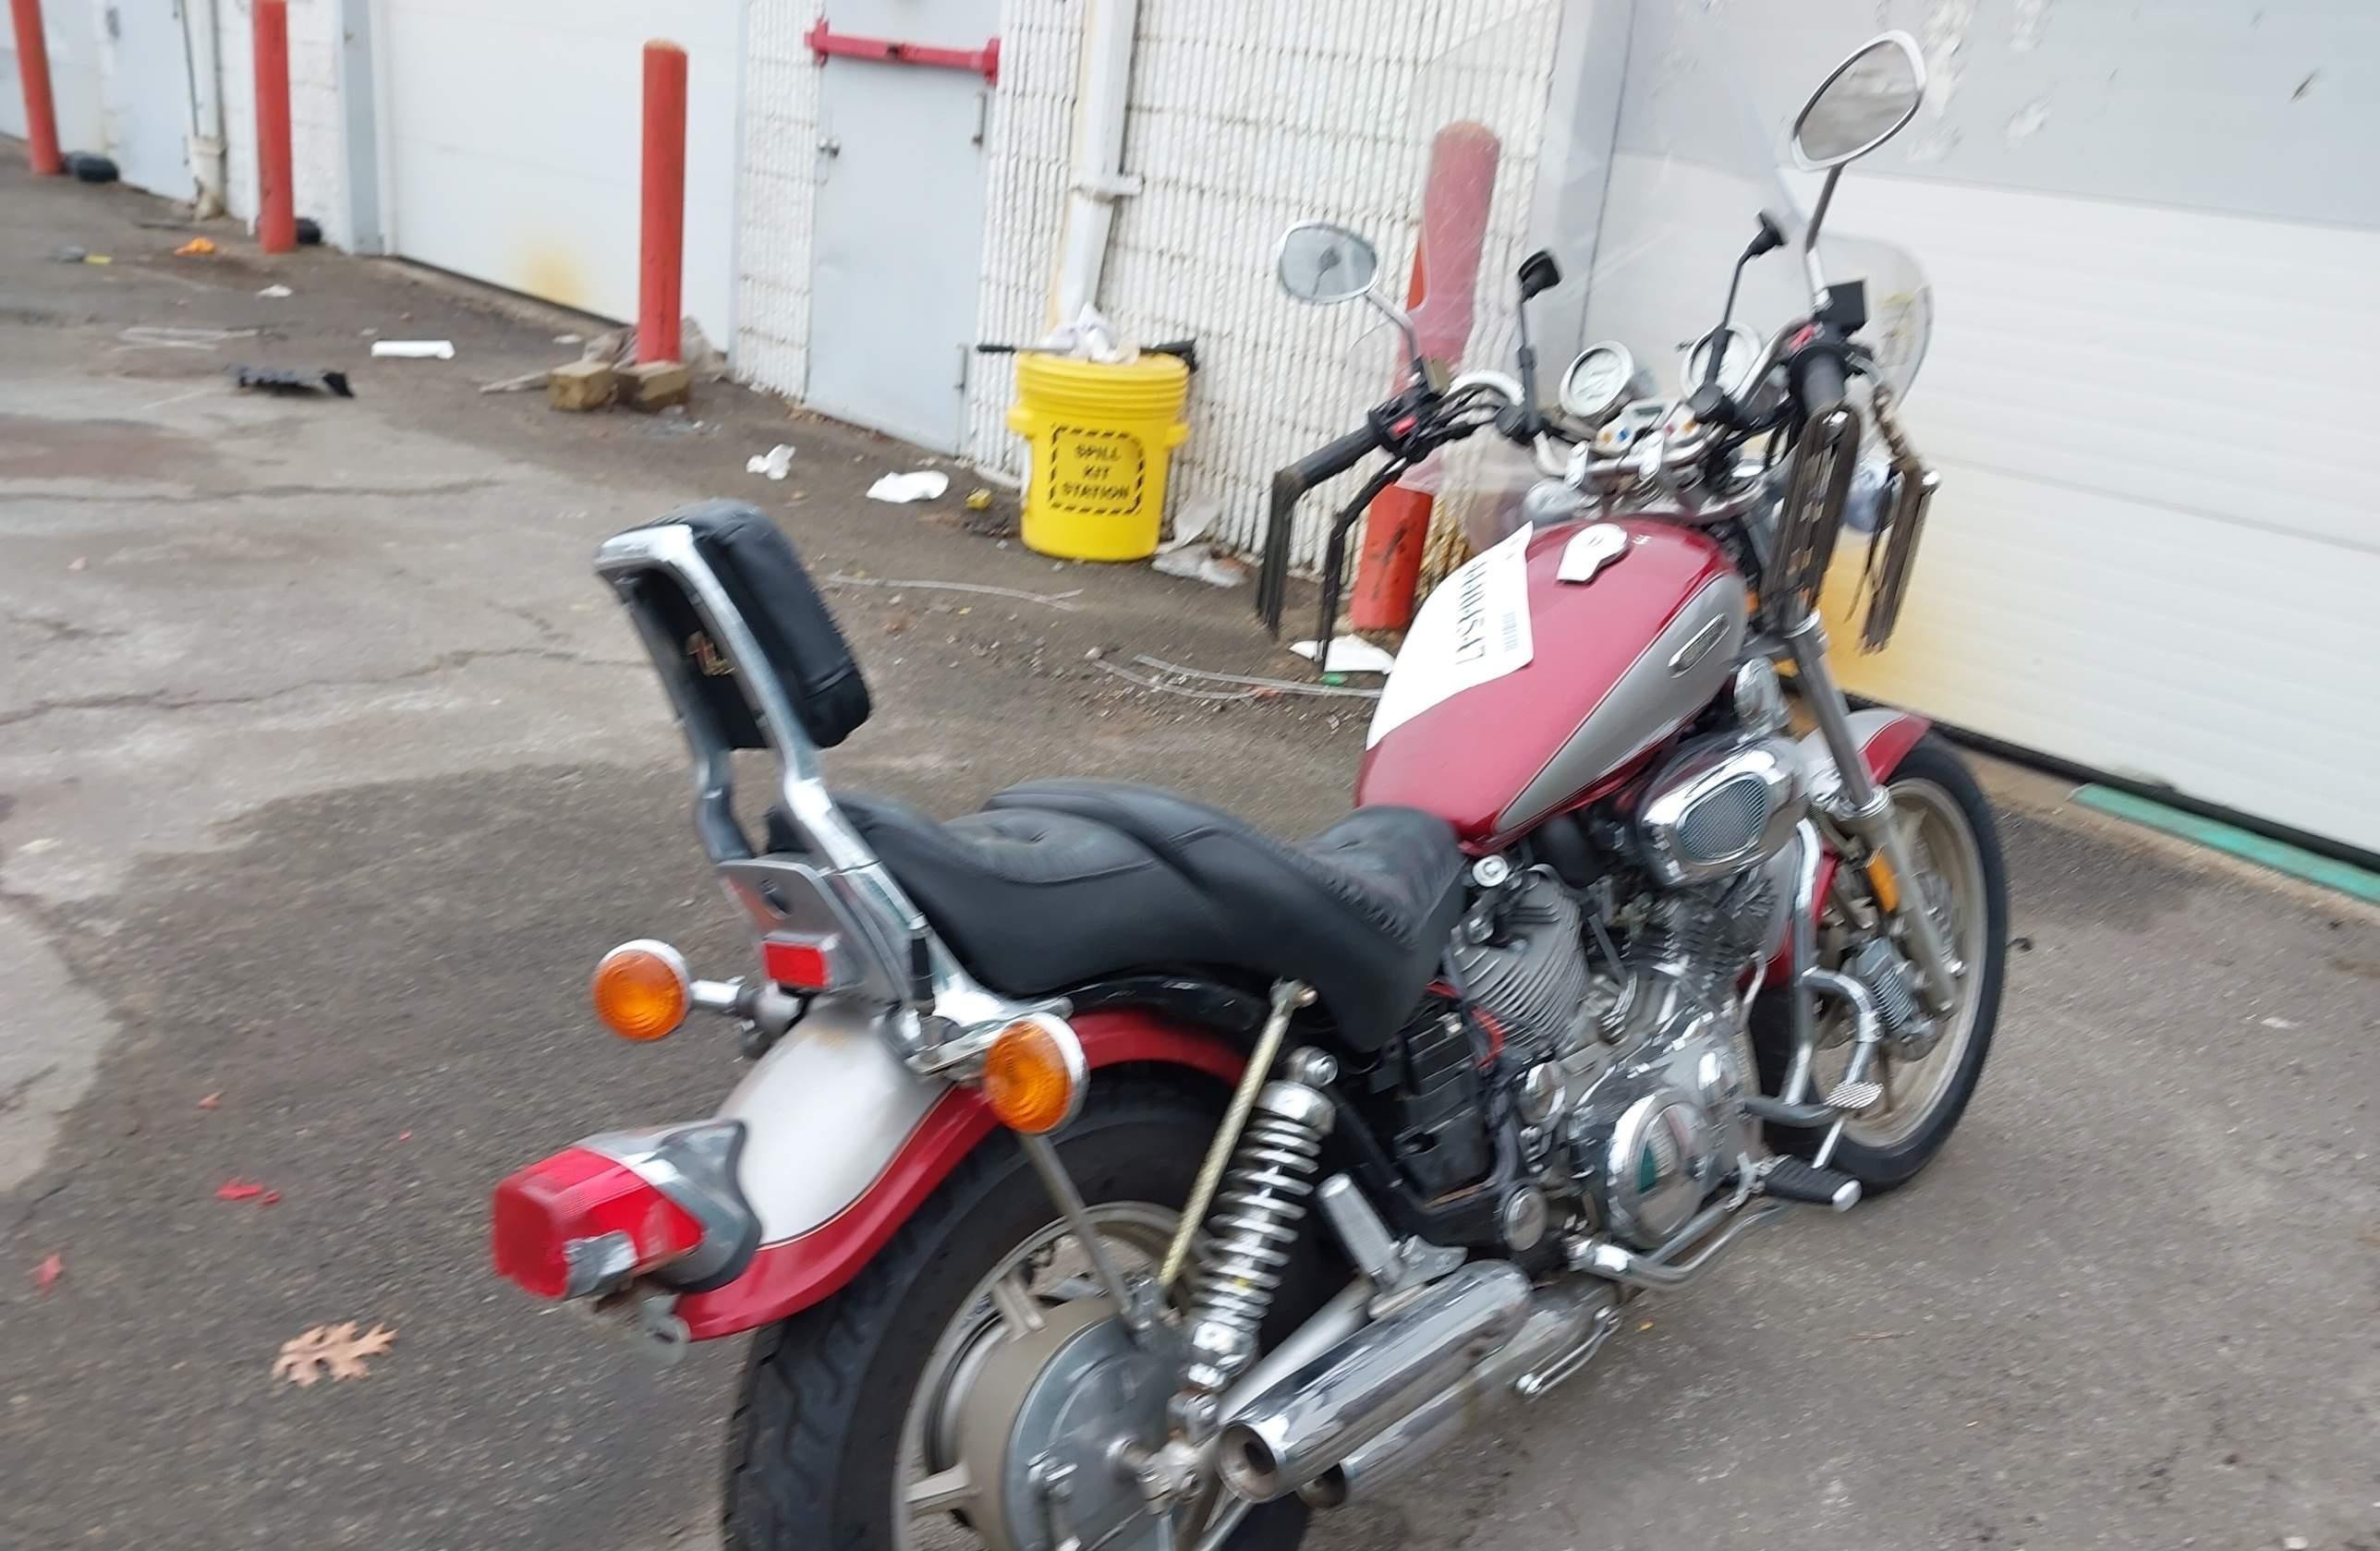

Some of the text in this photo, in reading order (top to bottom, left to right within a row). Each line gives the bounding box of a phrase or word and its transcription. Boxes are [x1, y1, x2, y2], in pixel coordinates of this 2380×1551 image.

[1075, 443, 1121, 462] SPILL
[1083, 464, 1111, 480] KIT
[1062, 482, 1130, 500] STATION
